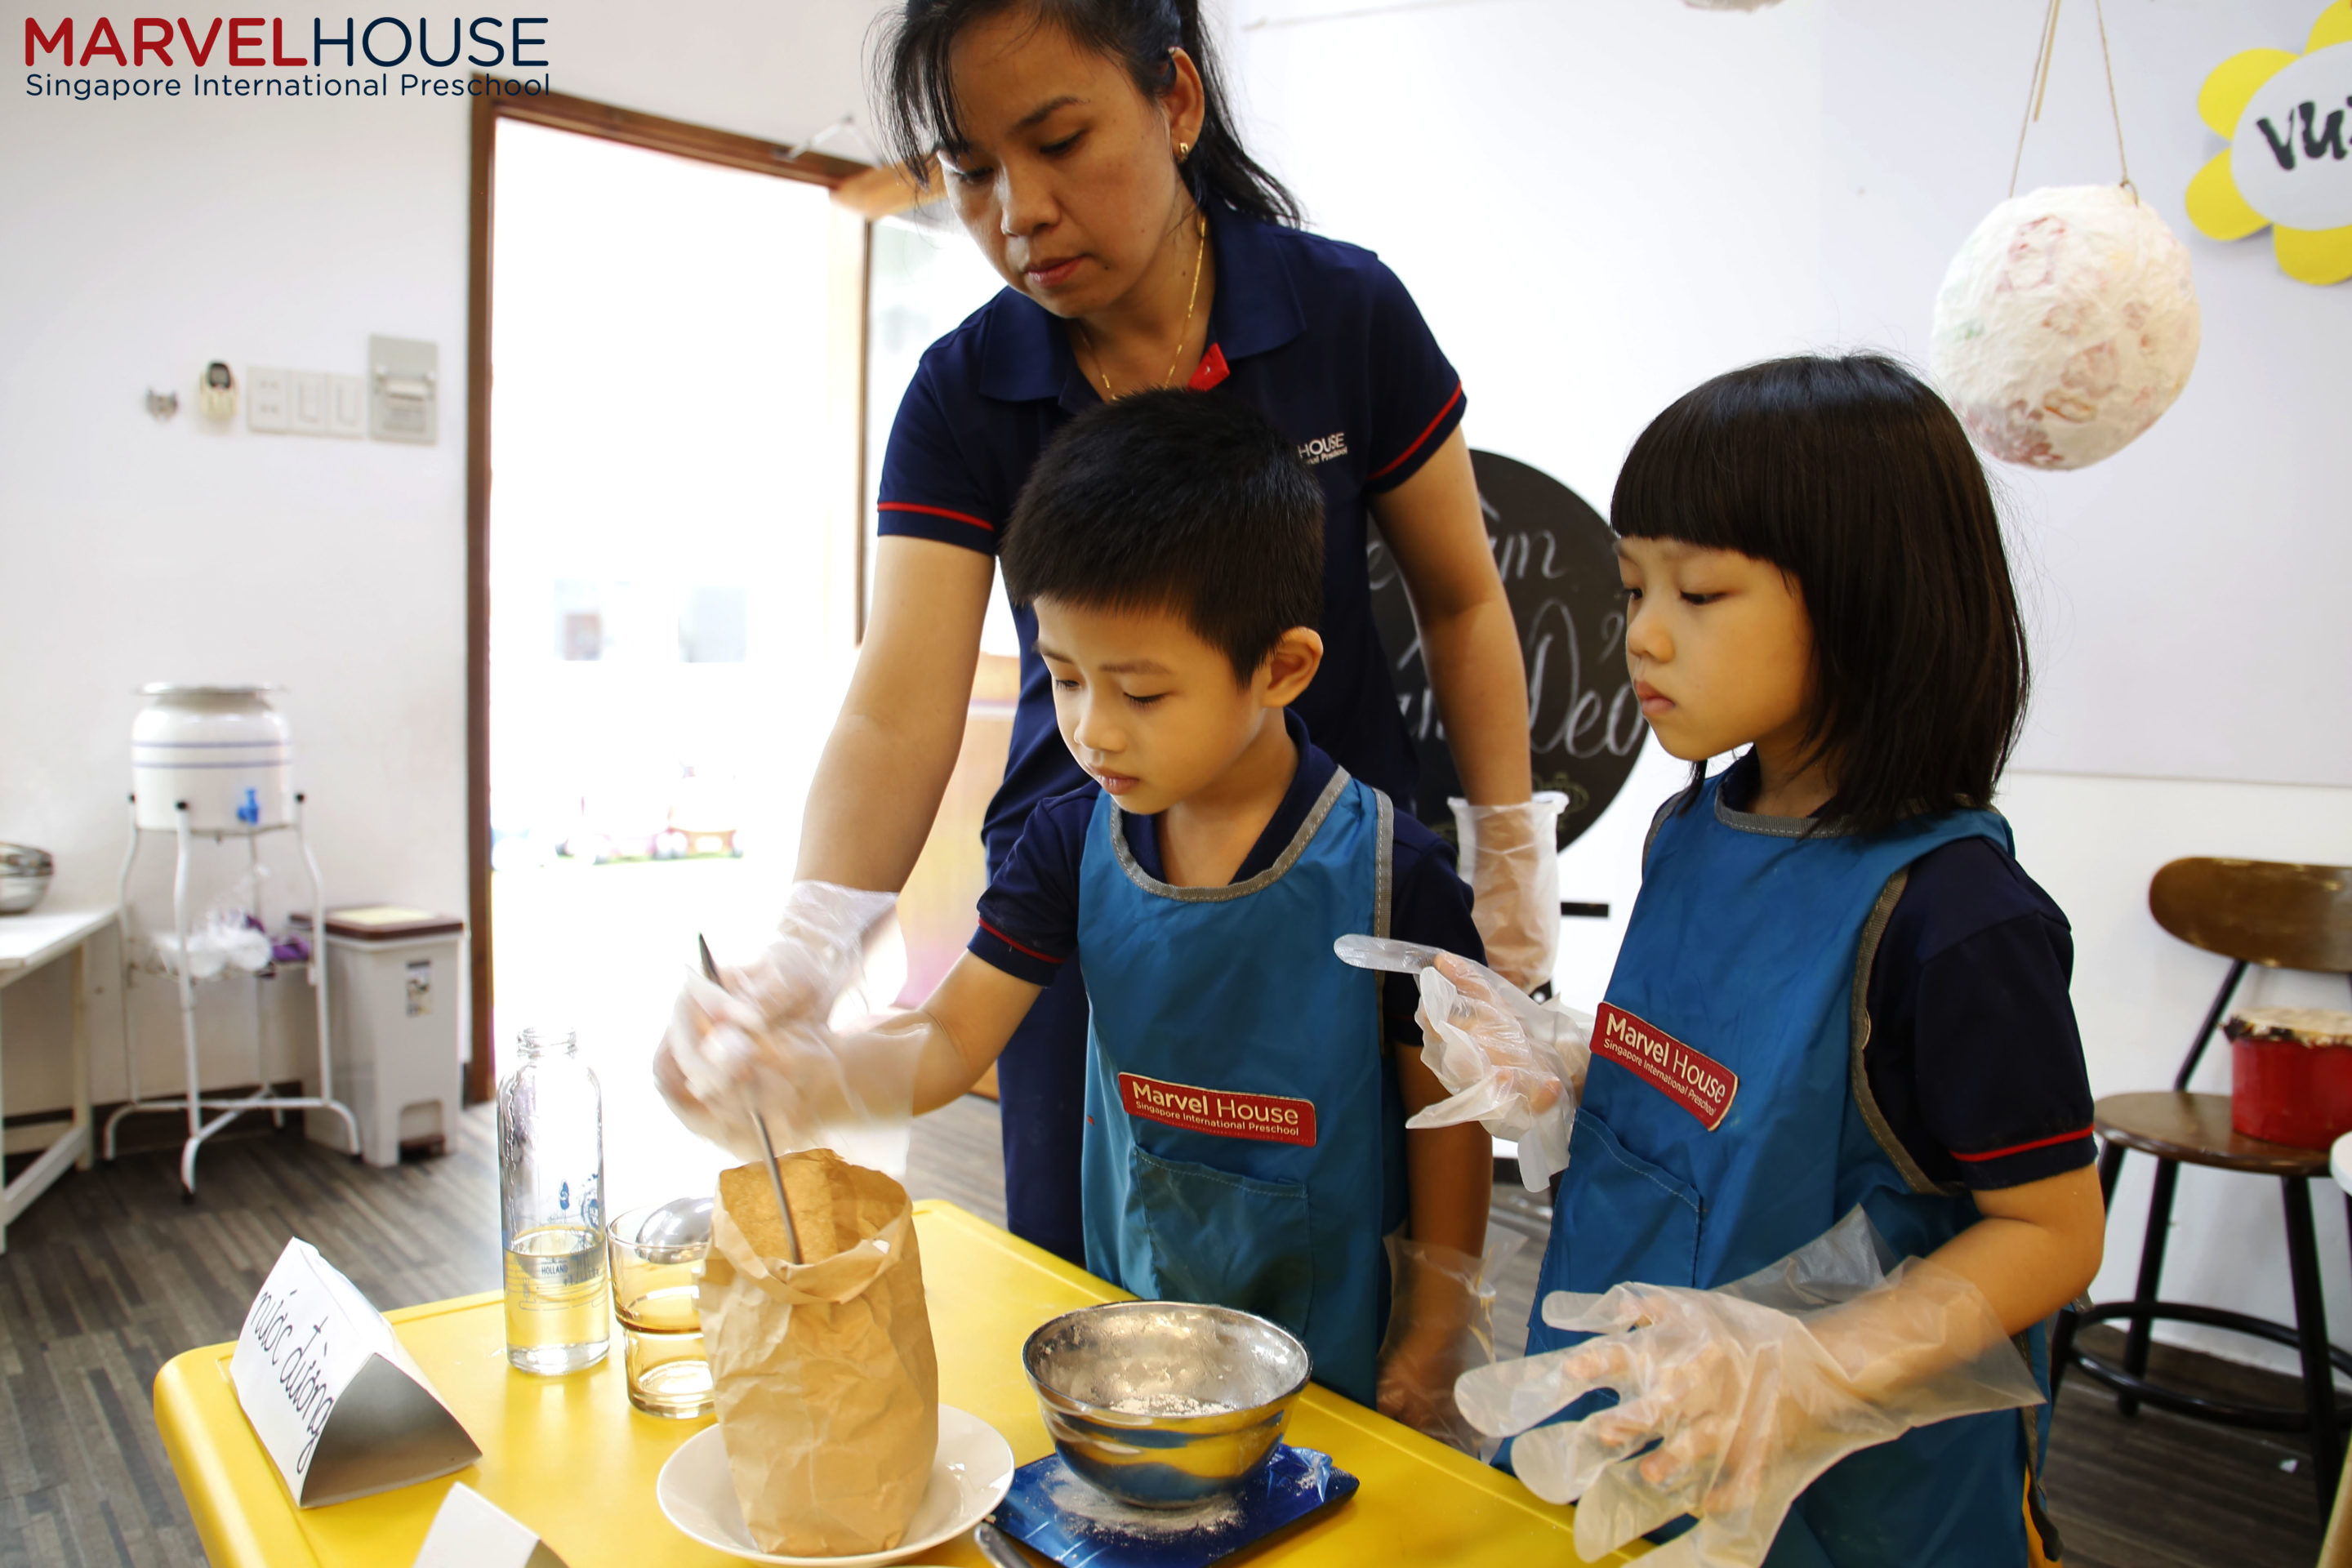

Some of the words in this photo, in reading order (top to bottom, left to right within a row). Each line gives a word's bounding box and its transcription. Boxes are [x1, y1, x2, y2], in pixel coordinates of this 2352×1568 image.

[1297, 433, 1345, 458] HOUSE
[1603, 1039, 1642, 1067] Singapore
[1643, 1059, 1688, 1095] International
[1606, 1013, 1669, 1067] Marvel
[1673, 1049, 1726, 1103] House
[1133, 1080, 1209, 1116] Marvel
[1217, 1098, 1298, 1125] House
[1136, 1101, 1181, 1120] Singapore
[1183, 1112, 1245, 1130] International
[1249, 1122, 1299, 1136] Preschool
[541, 1265, 568, 1275] HOLLAND
